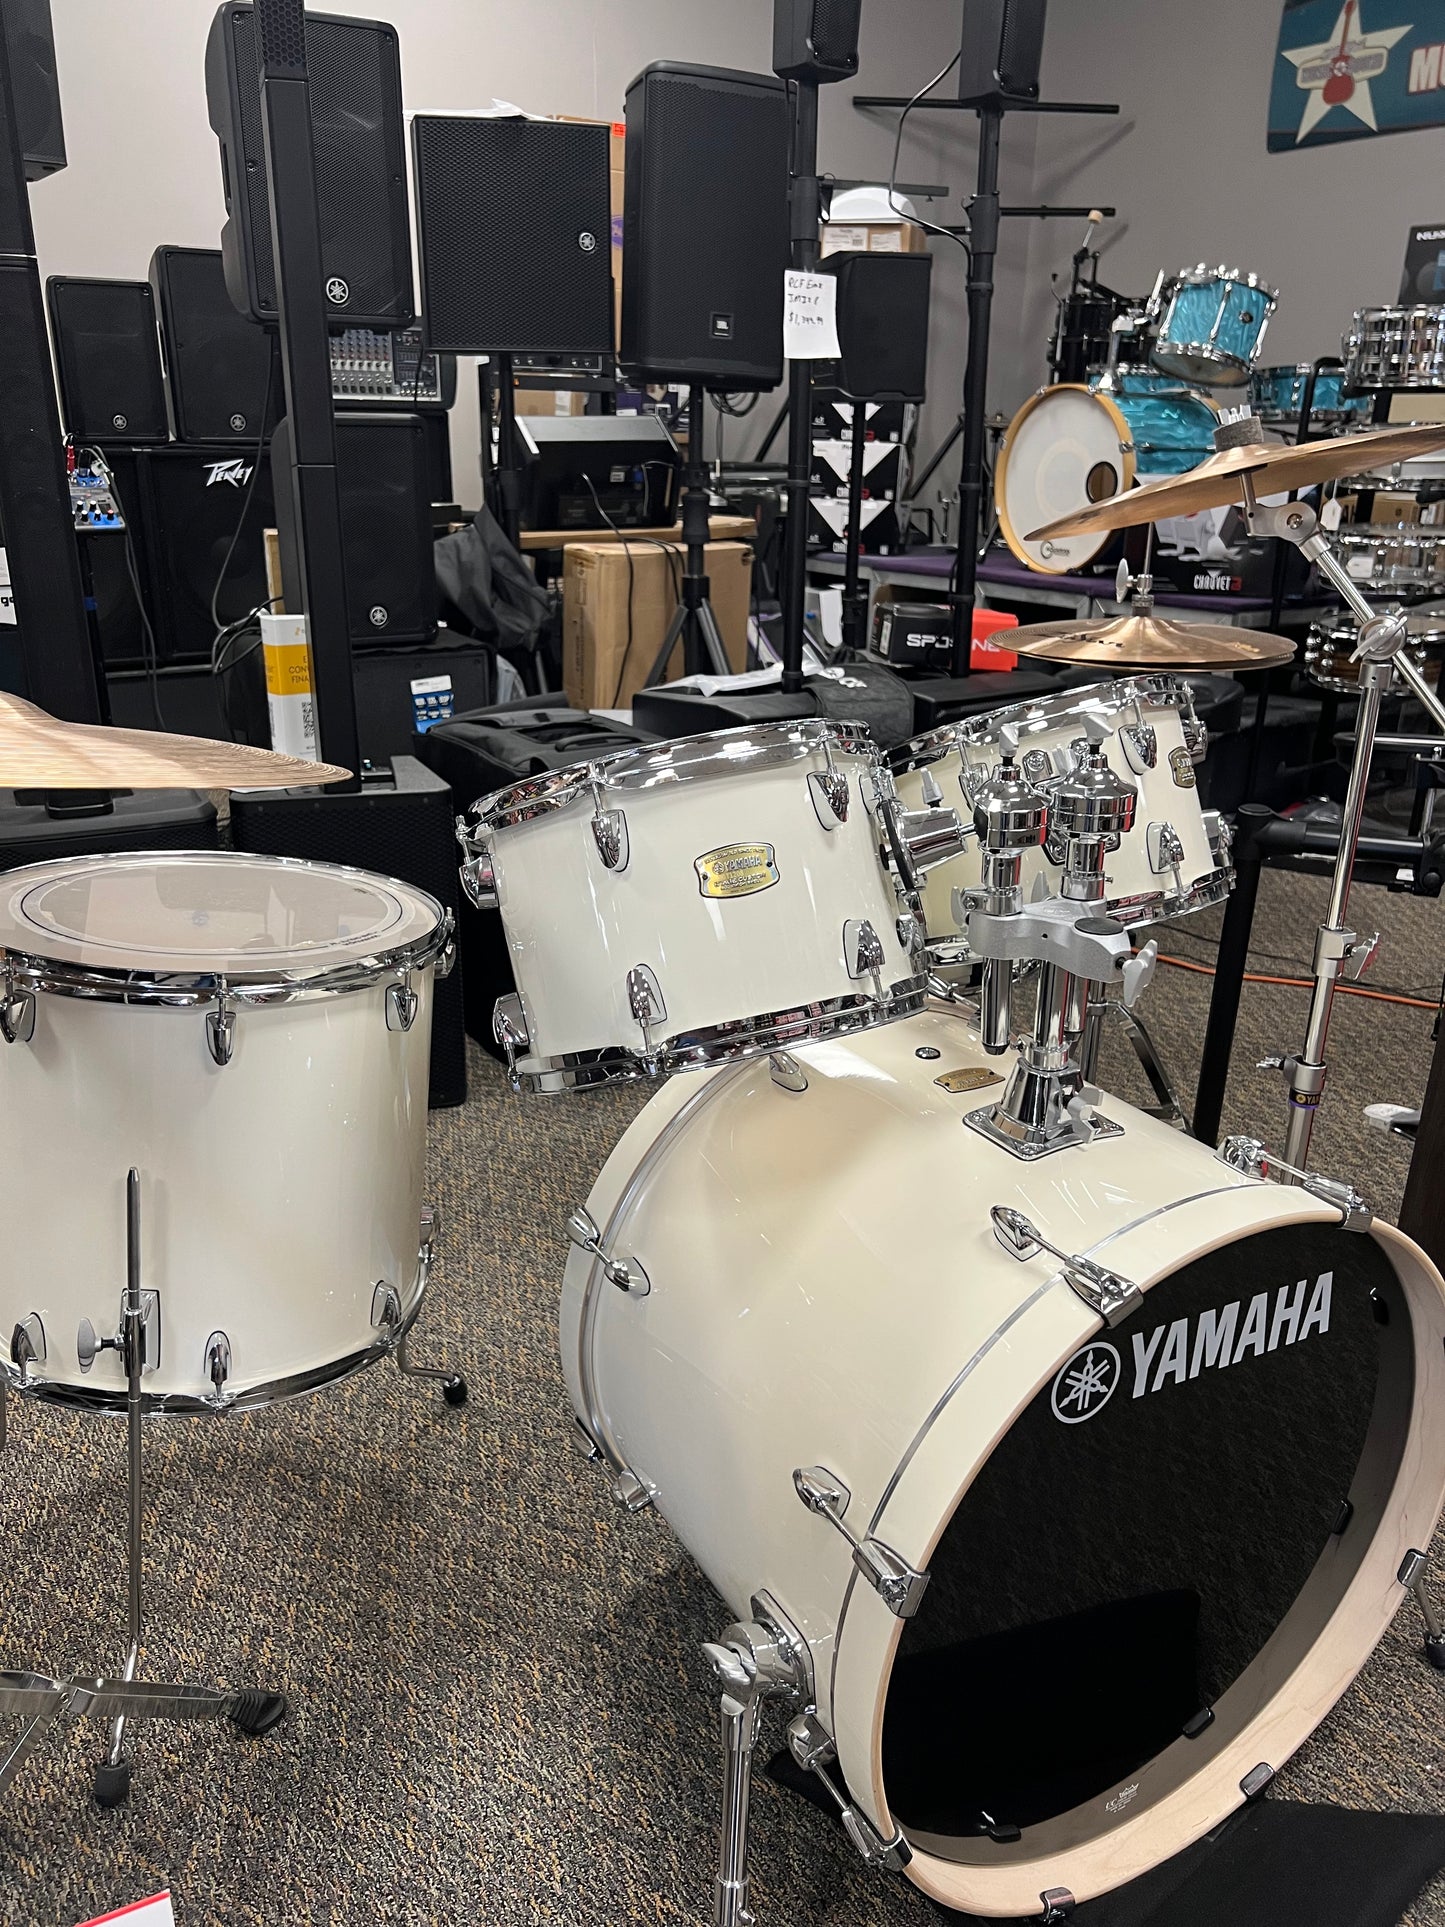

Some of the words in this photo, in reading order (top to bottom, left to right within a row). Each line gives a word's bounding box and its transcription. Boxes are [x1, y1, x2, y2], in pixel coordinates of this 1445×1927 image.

[202, 458, 253, 488] PEAVEY
[725, 856, 762, 871] YAMAHA
[1132, 1271, 1333, 1399] YAMAHA
